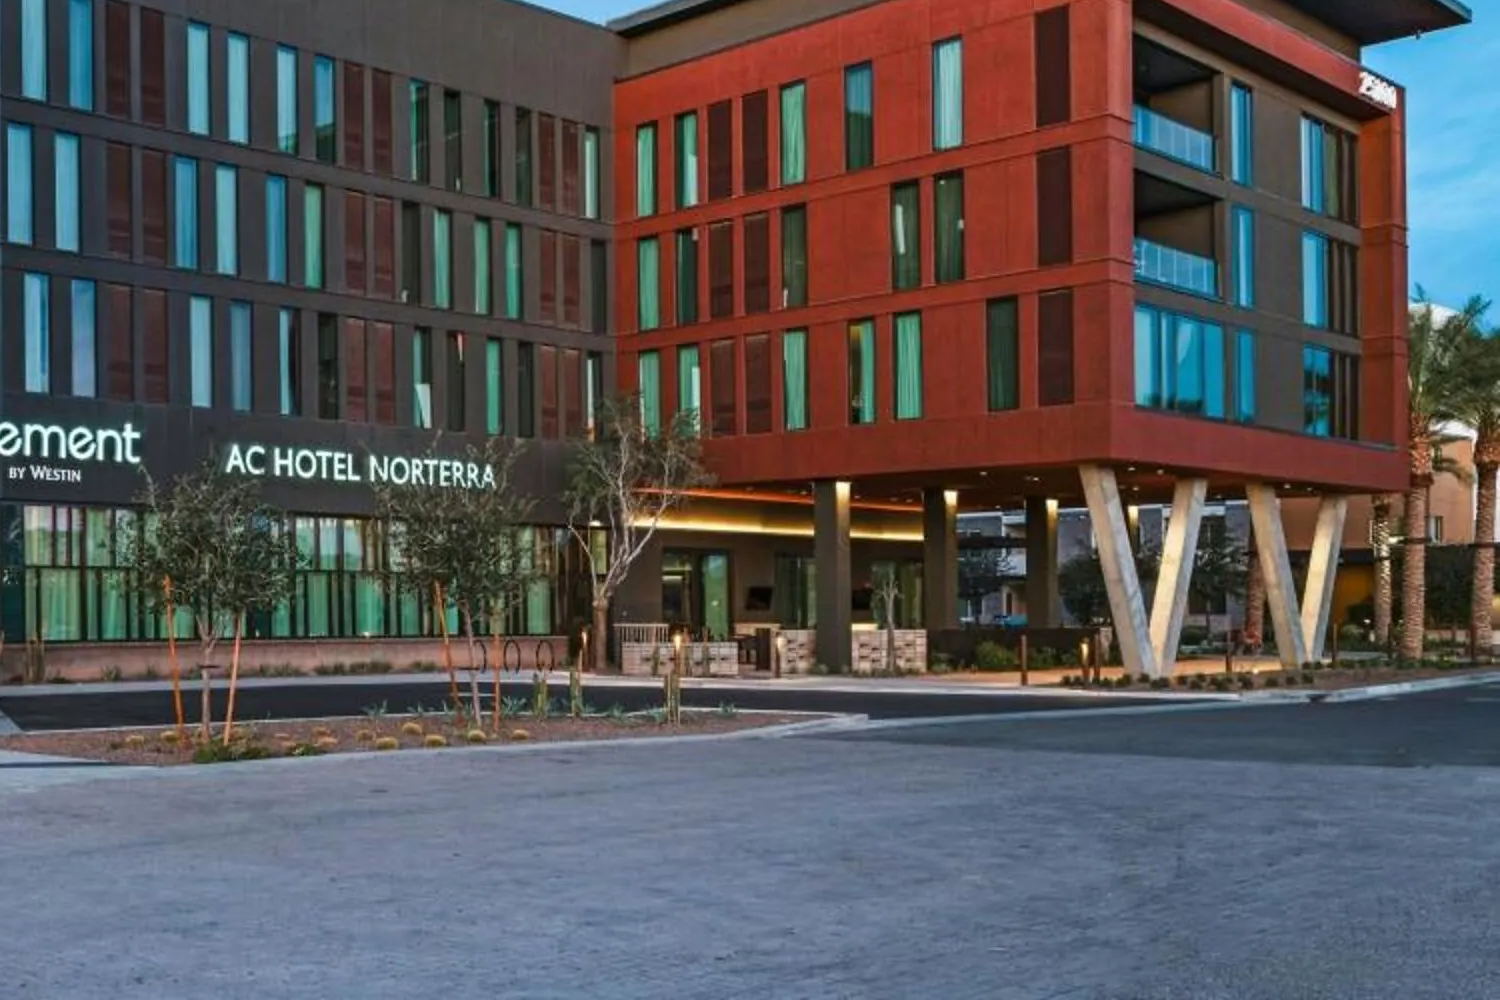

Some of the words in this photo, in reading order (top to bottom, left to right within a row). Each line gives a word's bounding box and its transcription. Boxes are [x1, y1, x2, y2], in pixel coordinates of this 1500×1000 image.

[8, 466, 26, 479] BY
[225, 443, 266, 475] AC
[273, 447, 361, 481] HOTEL
[369, 454, 497, 489] NORTERRA
